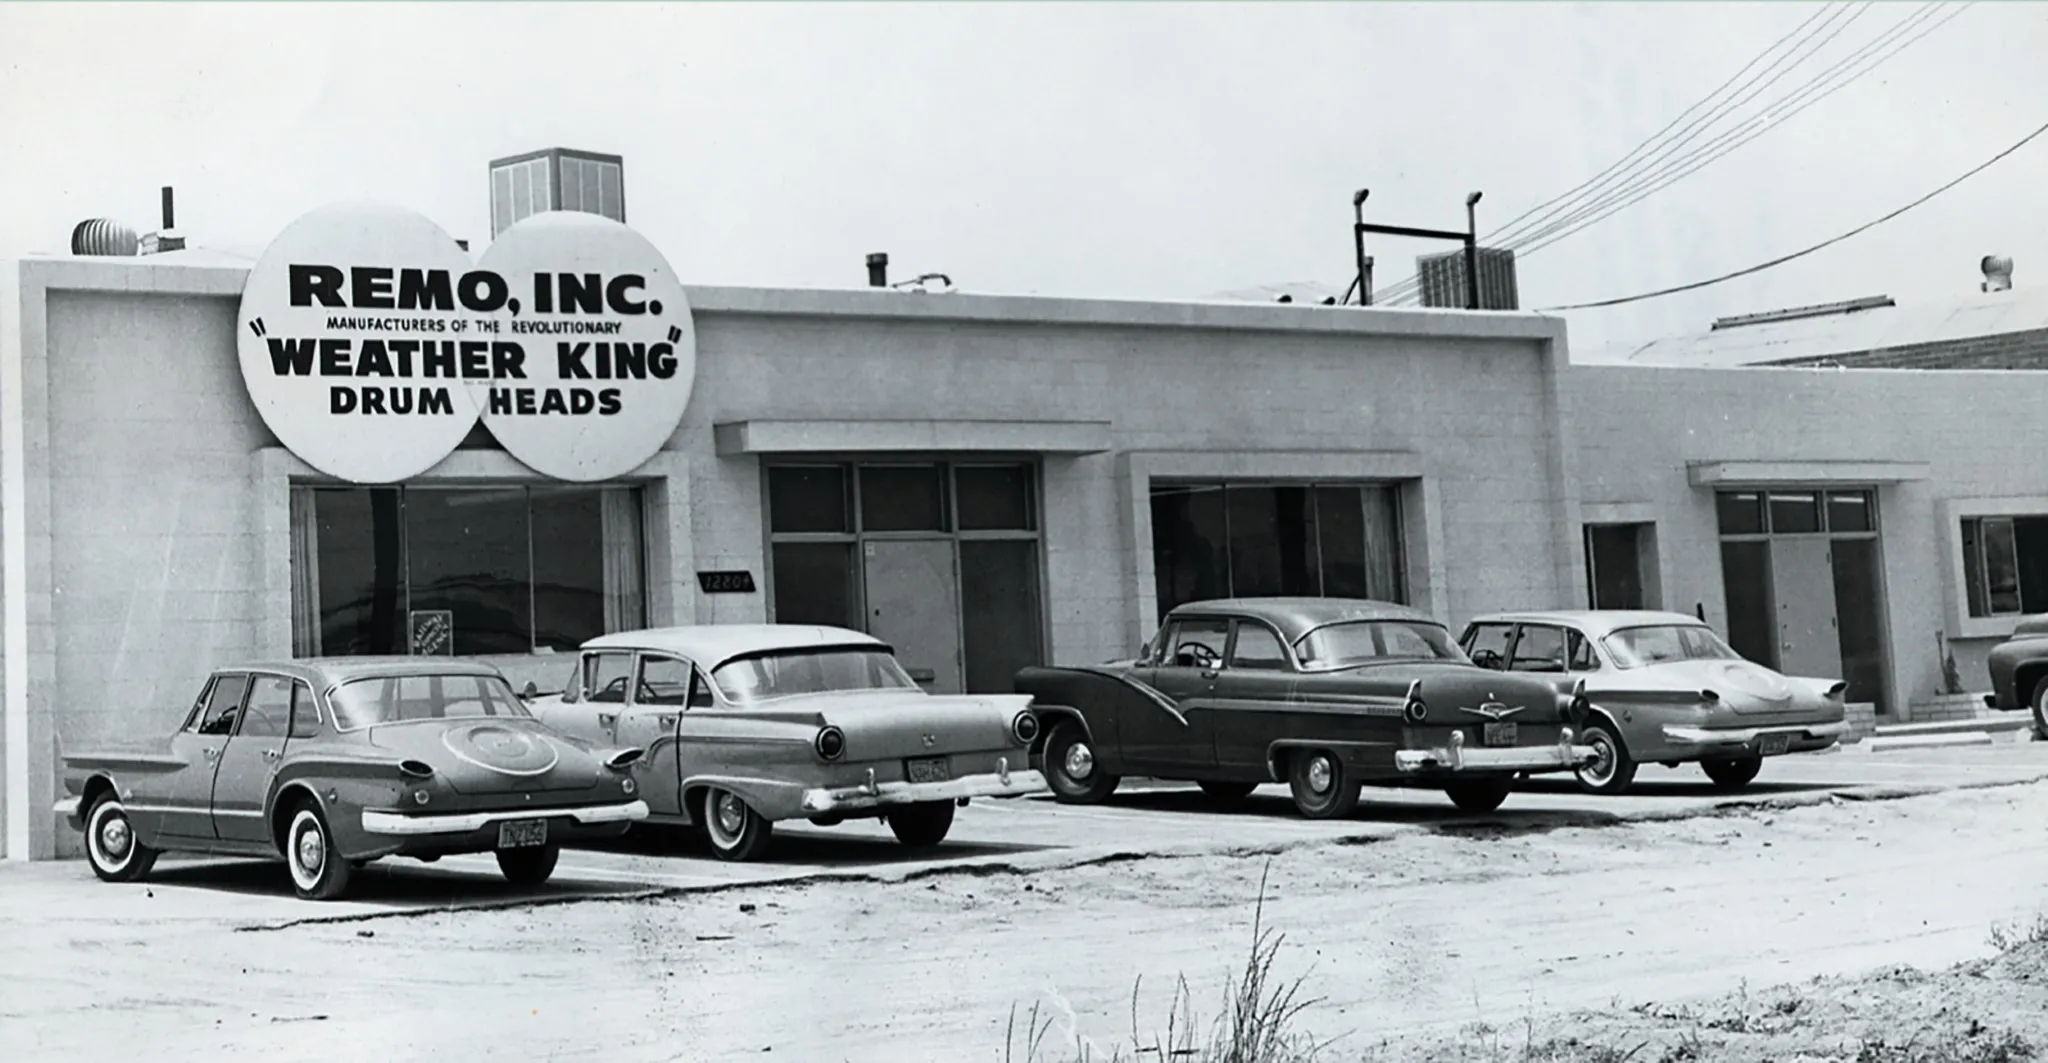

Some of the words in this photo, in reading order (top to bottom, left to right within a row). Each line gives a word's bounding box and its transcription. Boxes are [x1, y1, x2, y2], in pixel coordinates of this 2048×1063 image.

[288, 263, 521, 317] REMO,
[533, 272, 664, 316] INC.
[326, 316, 446, 333] MANUFACTURERS
[450, 319, 468, 333] OF
[475, 319, 500, 334] THE
[511, 320, 622, 335] REVOLUTIONARY
[330, 386, 454, 415] DRUM
[489, 387, 622, 416] HEADS
